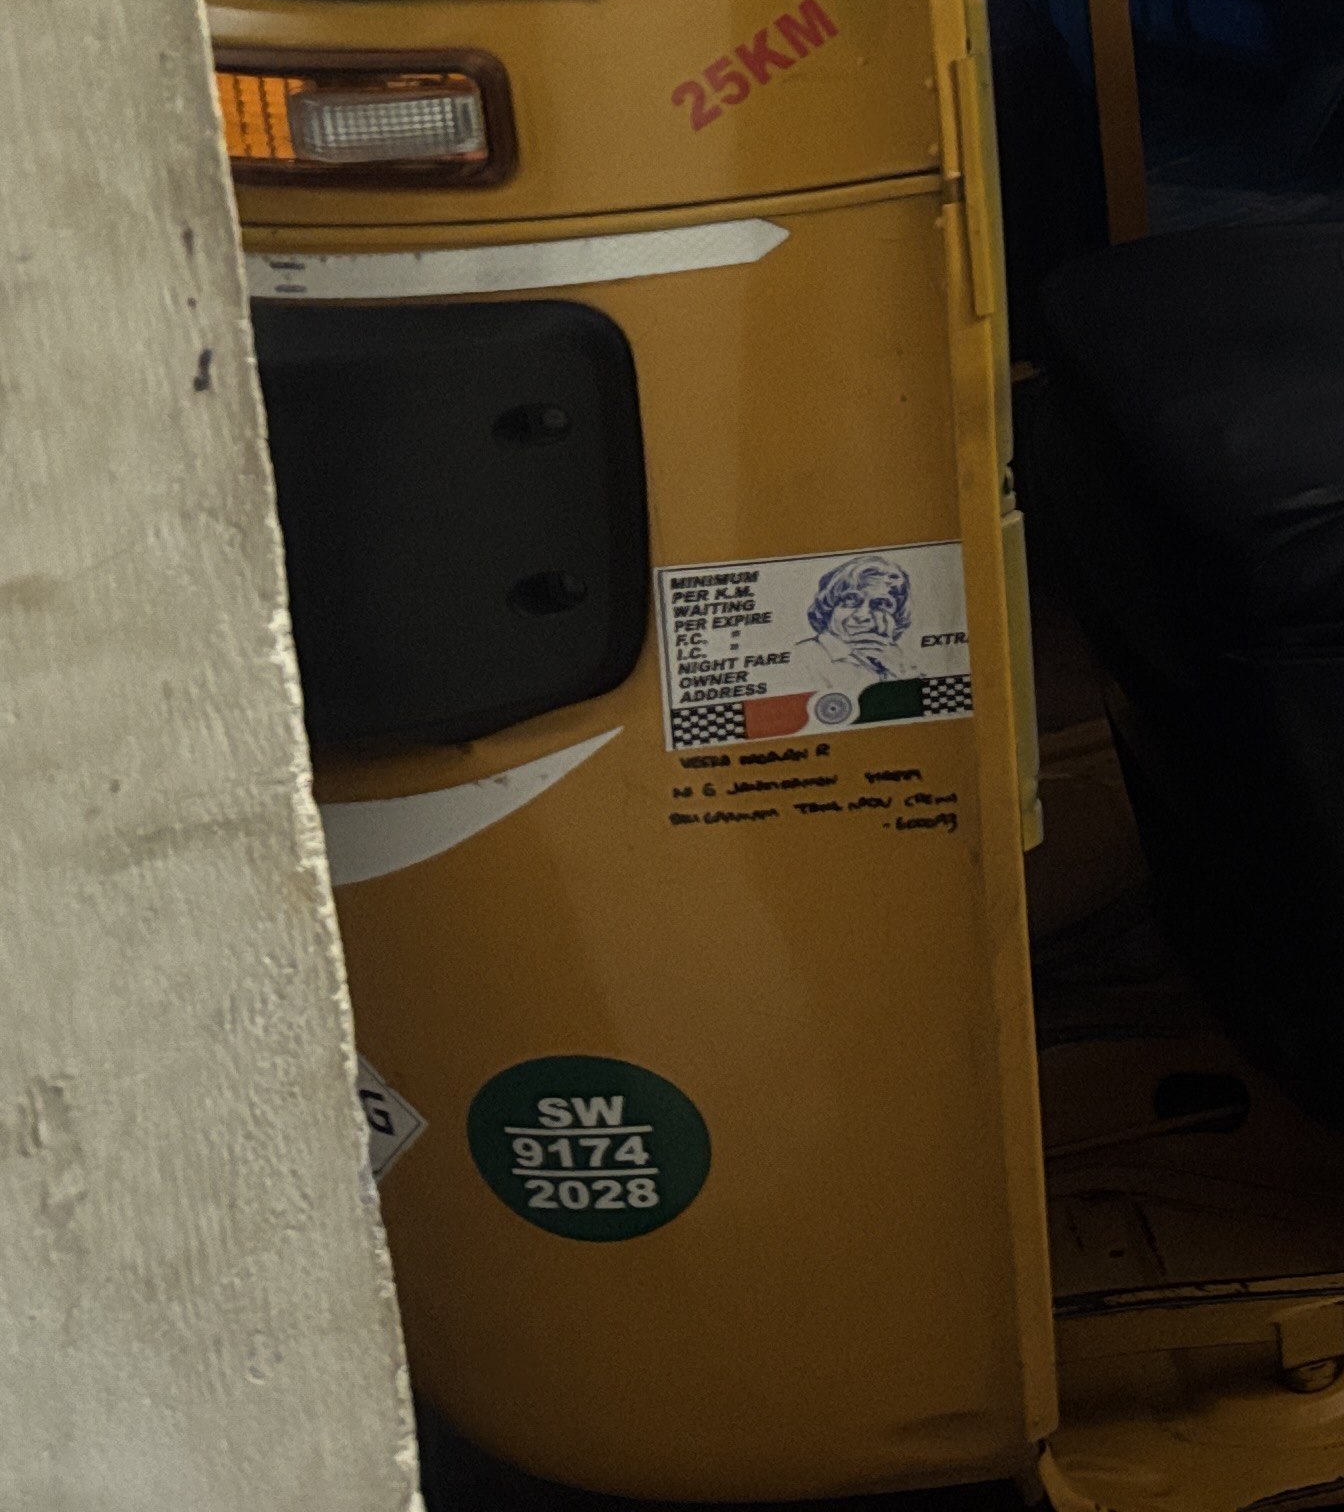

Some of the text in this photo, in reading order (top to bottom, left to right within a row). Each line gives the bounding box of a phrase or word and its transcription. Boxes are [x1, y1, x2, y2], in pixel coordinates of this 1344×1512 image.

[670, 570, 760, 590] MINIMUM
[671, 589, 710, 605] PER
[673, 599, 756, 618] WAITING
[674, 611, 773, 633] PER EXPIRE
[675, 632, 708, 647] F.C.
[920, 631, 969, 649] EXTR
[677, 651, 792, 675] NIGHT FARE
[679, 670, 750, 689] OWNER
[679, 682, 768, 704] ADDRESS
[537, 1095, 625, 1128] SW
[511, 1135, 650, 1168] 9174
[523, 1178, 660, 1210] 2028
